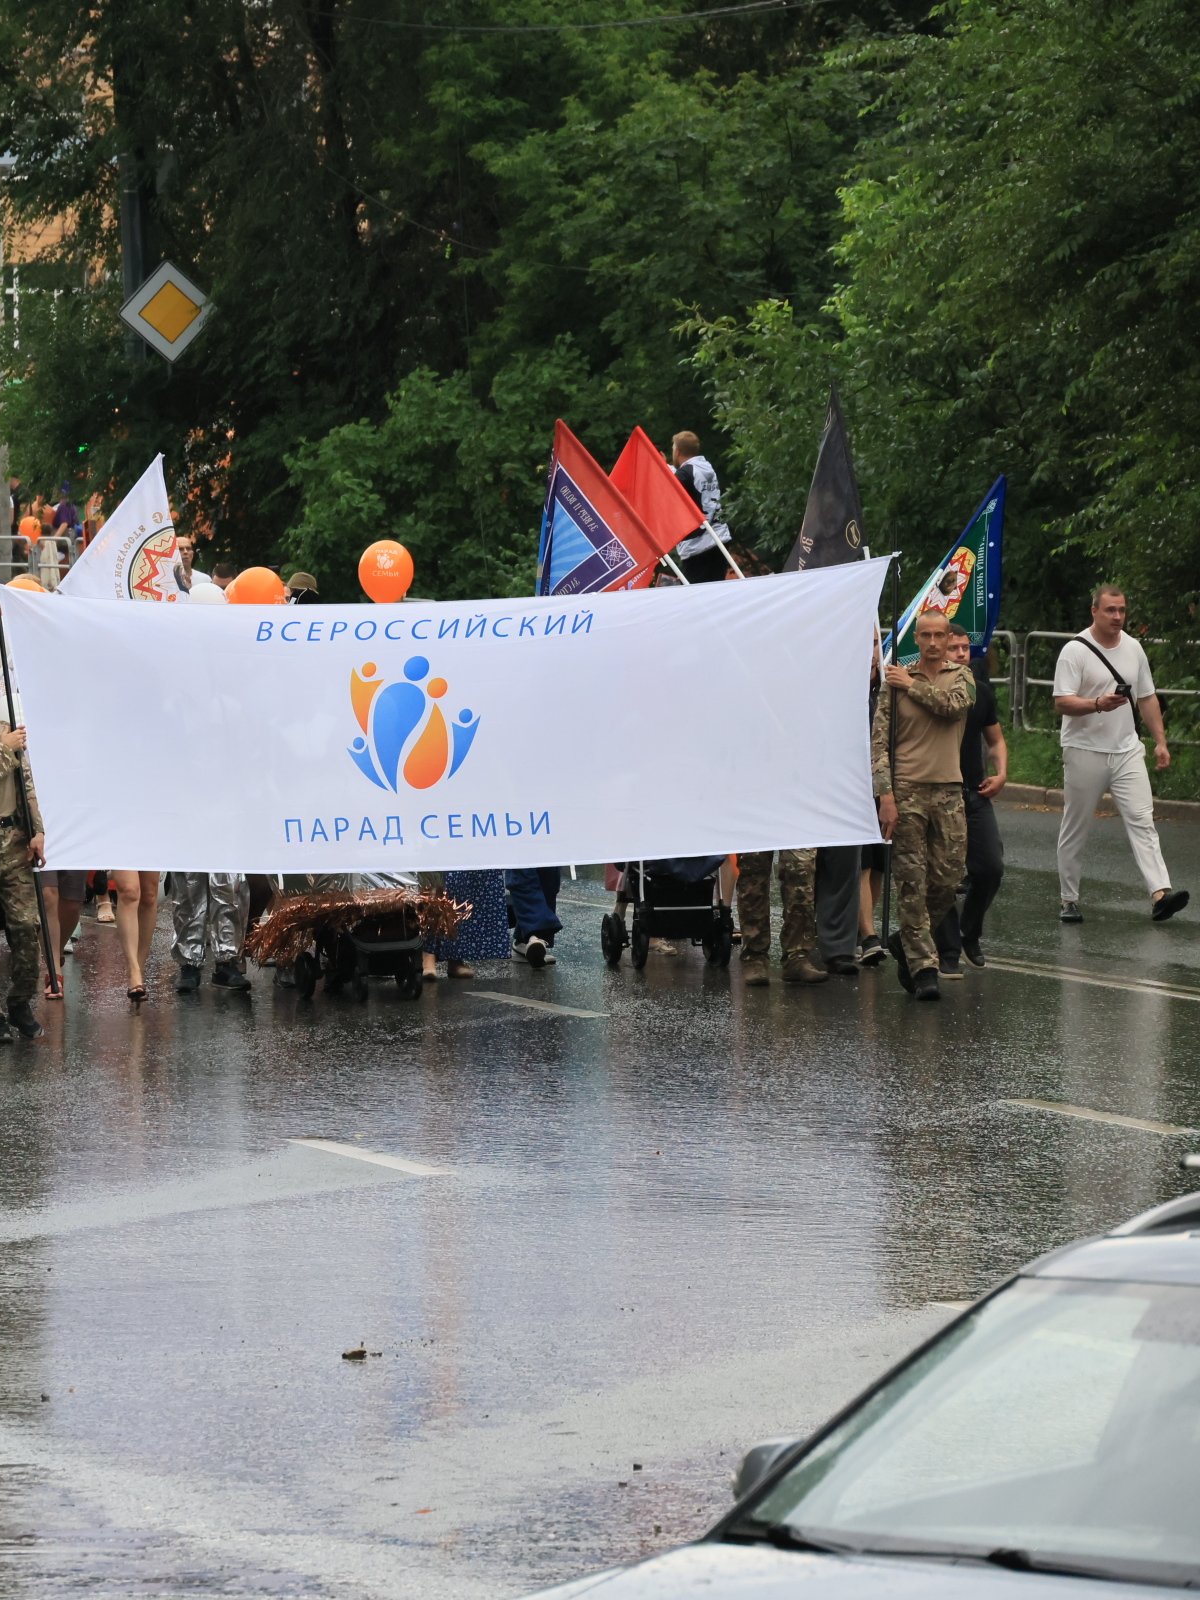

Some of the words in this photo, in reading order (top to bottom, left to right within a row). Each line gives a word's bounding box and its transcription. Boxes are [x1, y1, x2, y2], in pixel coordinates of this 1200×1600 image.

[256, 609, 594, 642] ВСЕРОССИЙСКИЙ
[284, 815, 404, 846] ПАРАД
[420, 811, 551, 839] СЕМЬИ
